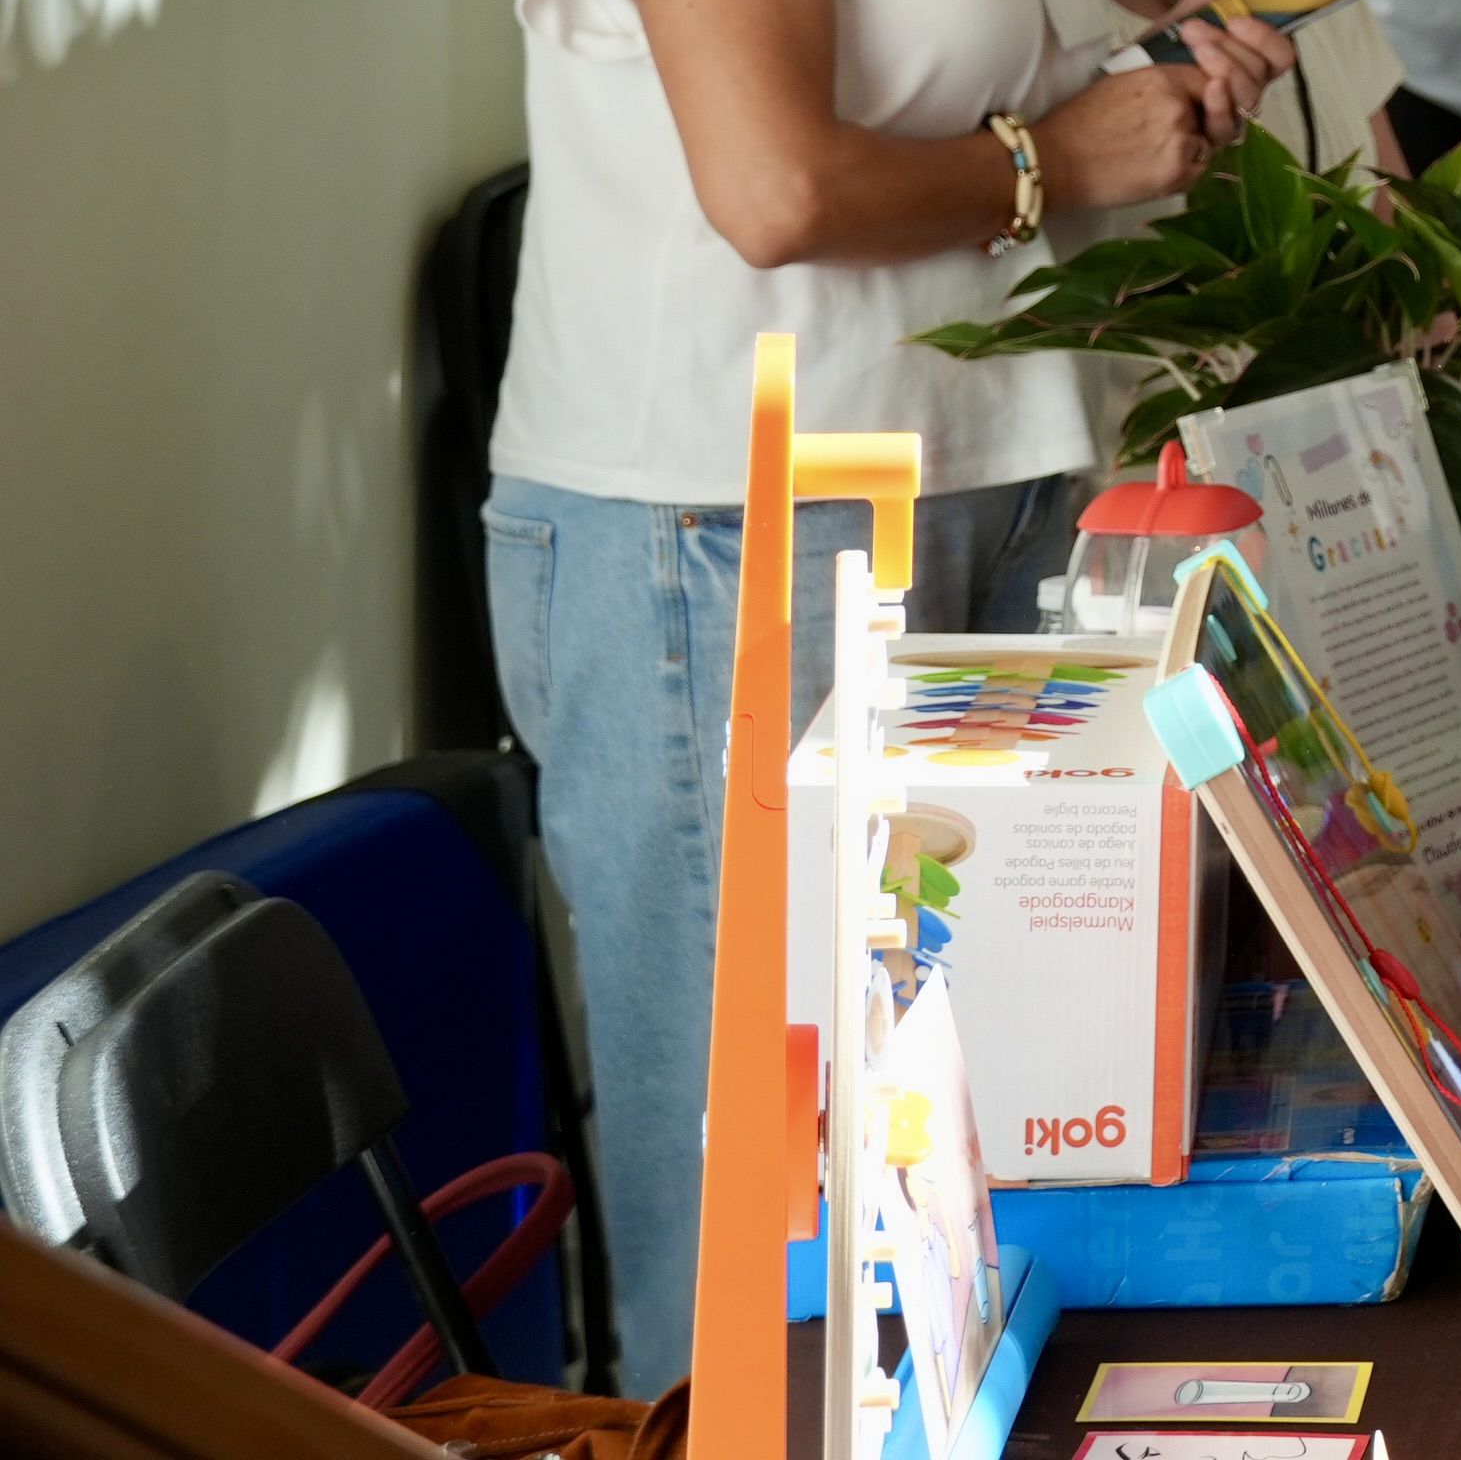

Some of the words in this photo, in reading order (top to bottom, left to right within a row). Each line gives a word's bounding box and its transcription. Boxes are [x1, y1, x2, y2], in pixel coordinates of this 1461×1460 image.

[1044, 803, 1079, 815] biglie
[1013, 824, 1063, 833] sonidos
[1066, 824, 1083, 833] de
[1087, 822, 1137, 834] pagoda
[1026, 839, 1073, 849] canicas
[1078, 839, 1095, 849] de
[1099, 838, 1136, 849] Juego
[1005, 855, 1055, 870] Pagode
[1058, 858, 1090, 869] billes
[1095, 858, 1111, 869] de
[1114, 858, 1136, 869] Jeu
[994, 875, 1045, 887] pagoda
[1050, 875, 1086, 886] game
[1090, 877, 1135, 889] Marble
[1019, 893, 1134, 911] Klangpagode
[1030, 913, 1134, 931] Murmelspiel
[1025, 1105, 1126, 1155] goki
